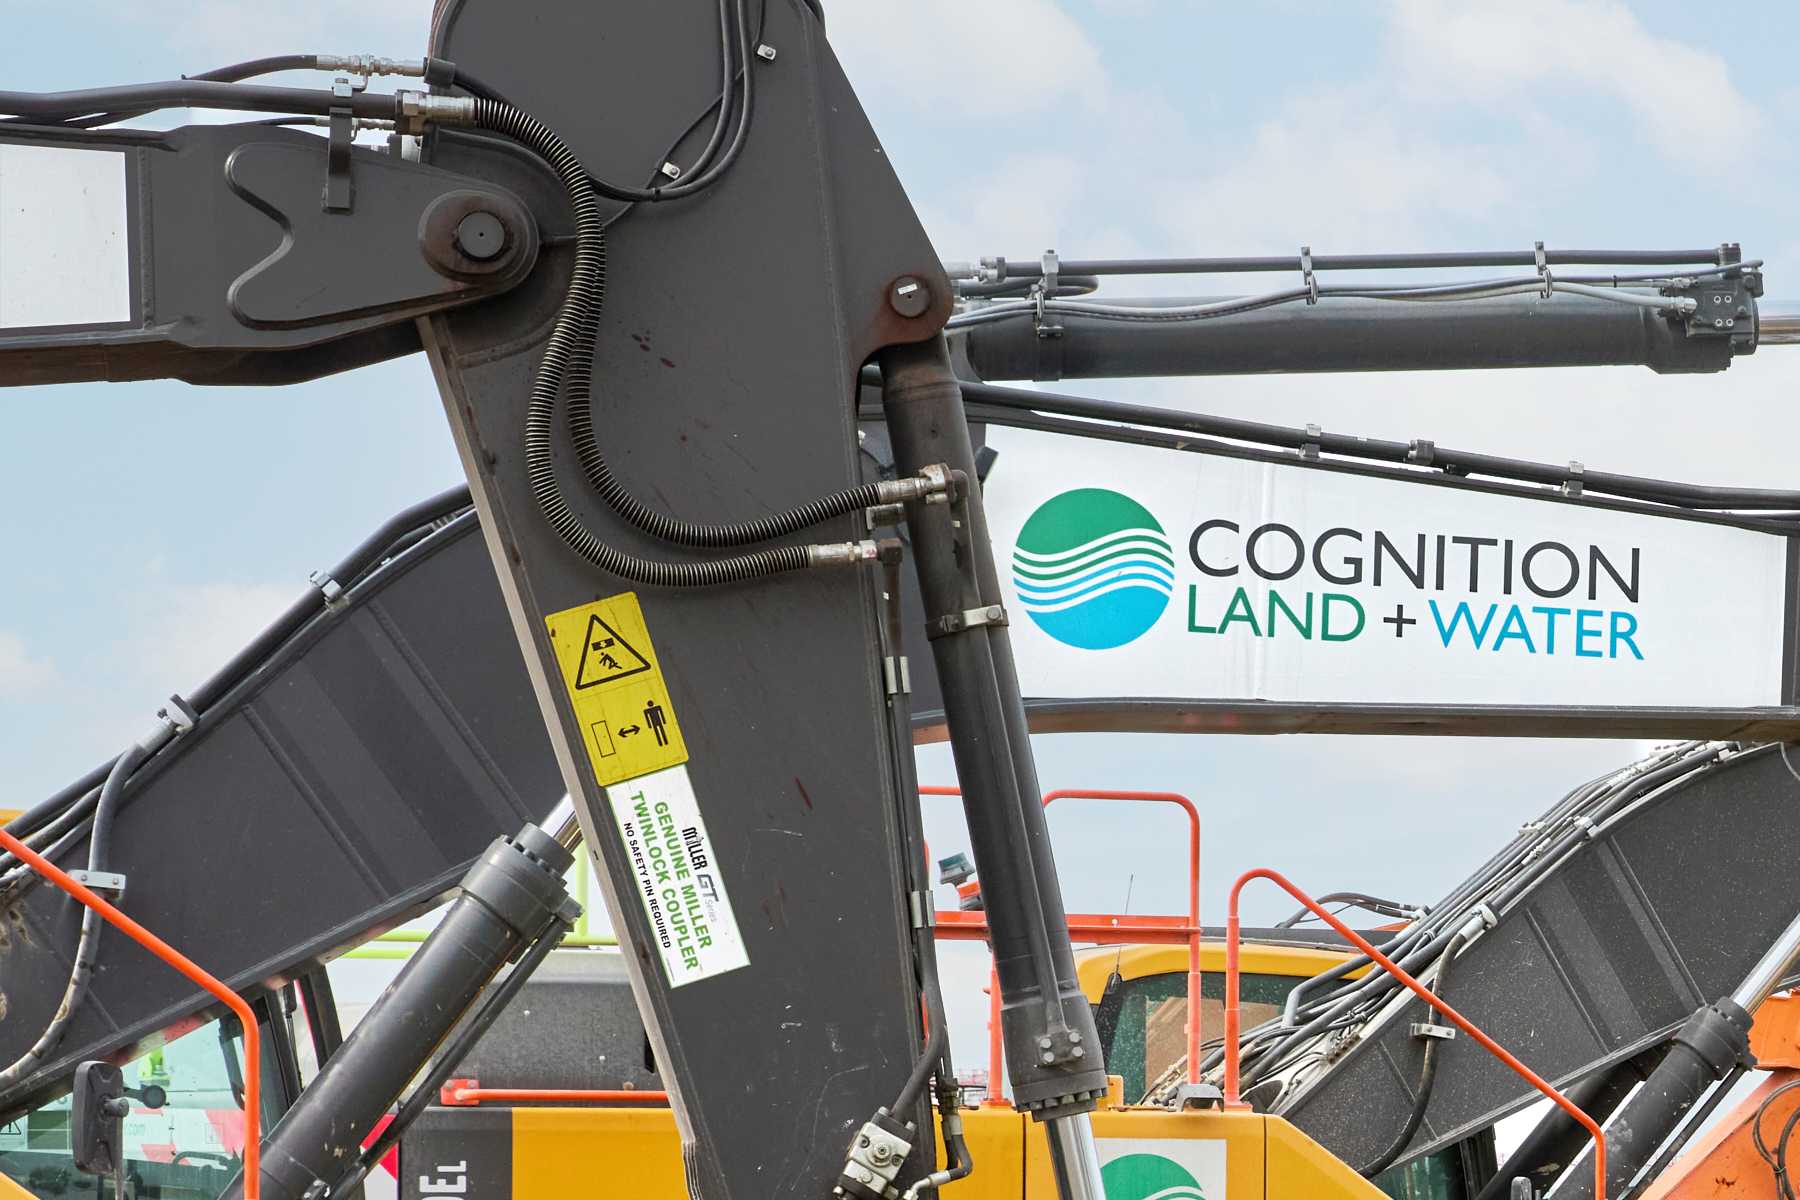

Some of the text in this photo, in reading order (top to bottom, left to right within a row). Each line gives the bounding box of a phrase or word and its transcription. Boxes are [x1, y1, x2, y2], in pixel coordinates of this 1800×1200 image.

[1189, 519, 1640, 603] COGNITION
[1187, 584, 1645, 660] LAND + WATER
[624, 822, 634, 837] NO
[629, 840, 649, 876] SAFETY
[643, 879, 654, 896] PIN
[649, 899, 671, 949] REQUIRED
[631, 790, 699, 970] TWINLOCK COUPLER
[655, 801, 712, 949] GENUINE MILLER
[682, 826, 708, 870] MILLER
